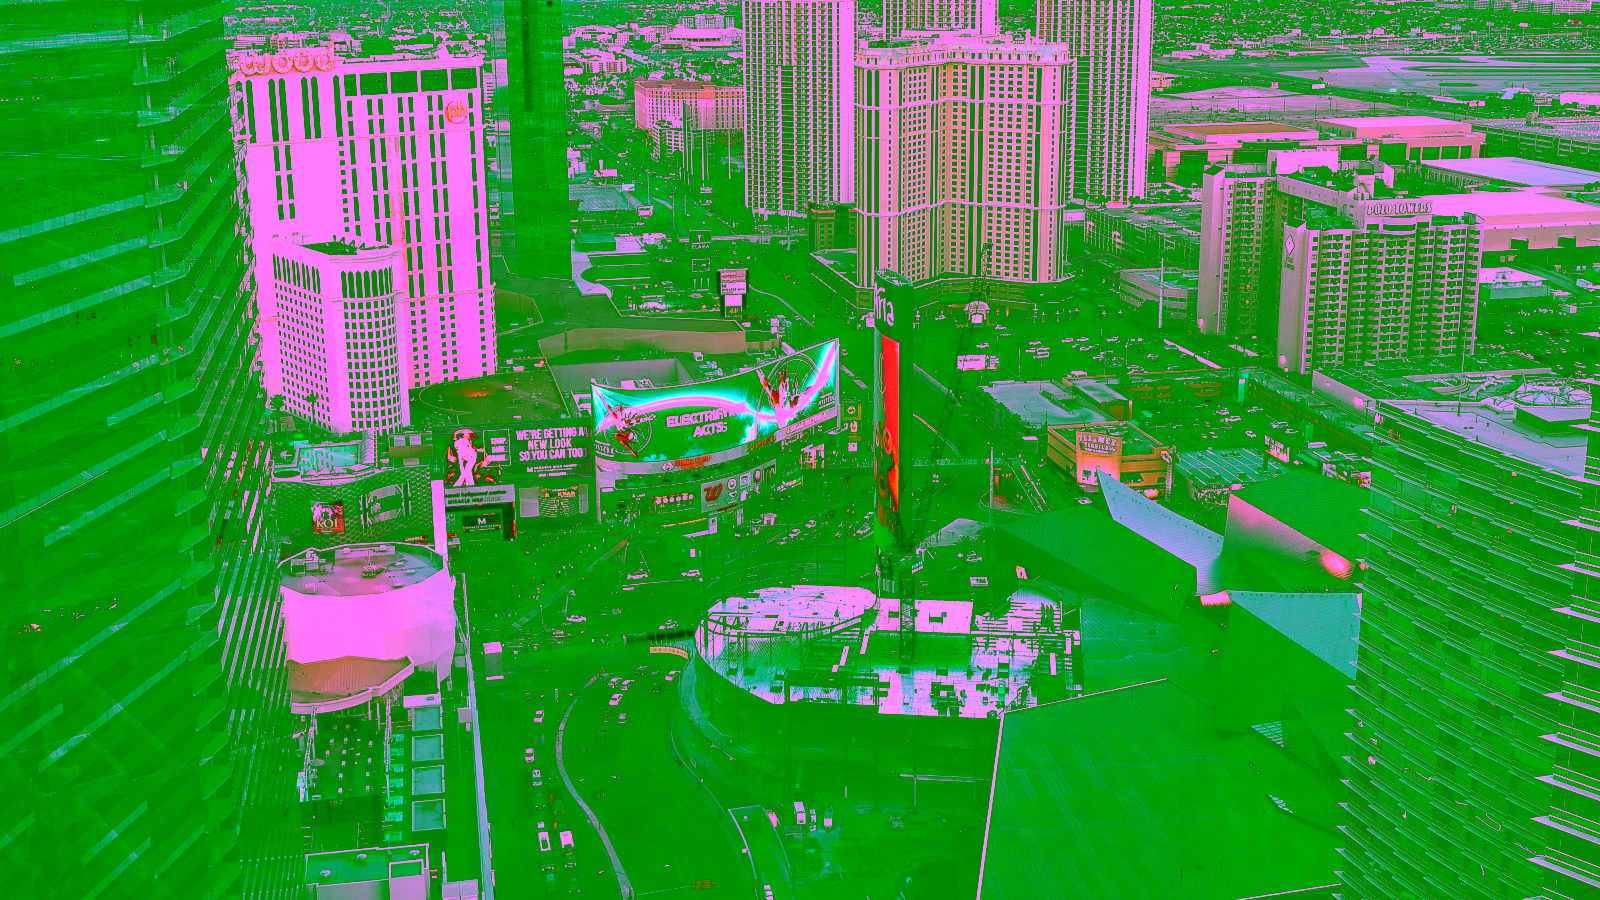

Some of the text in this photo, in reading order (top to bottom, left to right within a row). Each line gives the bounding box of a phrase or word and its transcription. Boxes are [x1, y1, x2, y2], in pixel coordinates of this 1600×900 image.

[1367, 202, 1432, 216] POLO TOWERS
[516, 429, 542, 440] WE'RE
[543, 427, 577, 439] GETTING
[692, 421, 728, 438] ACTS
[527, 438, 573, 450] NEW LOOK
[1084, 442, 1109, 451] TEQUILA
[519, 451, 531, 461] SO
[531, 450, 548, 461] YOU
[549, 449, 566, 460] CAN
[316, 518, 338, 529] KOI
